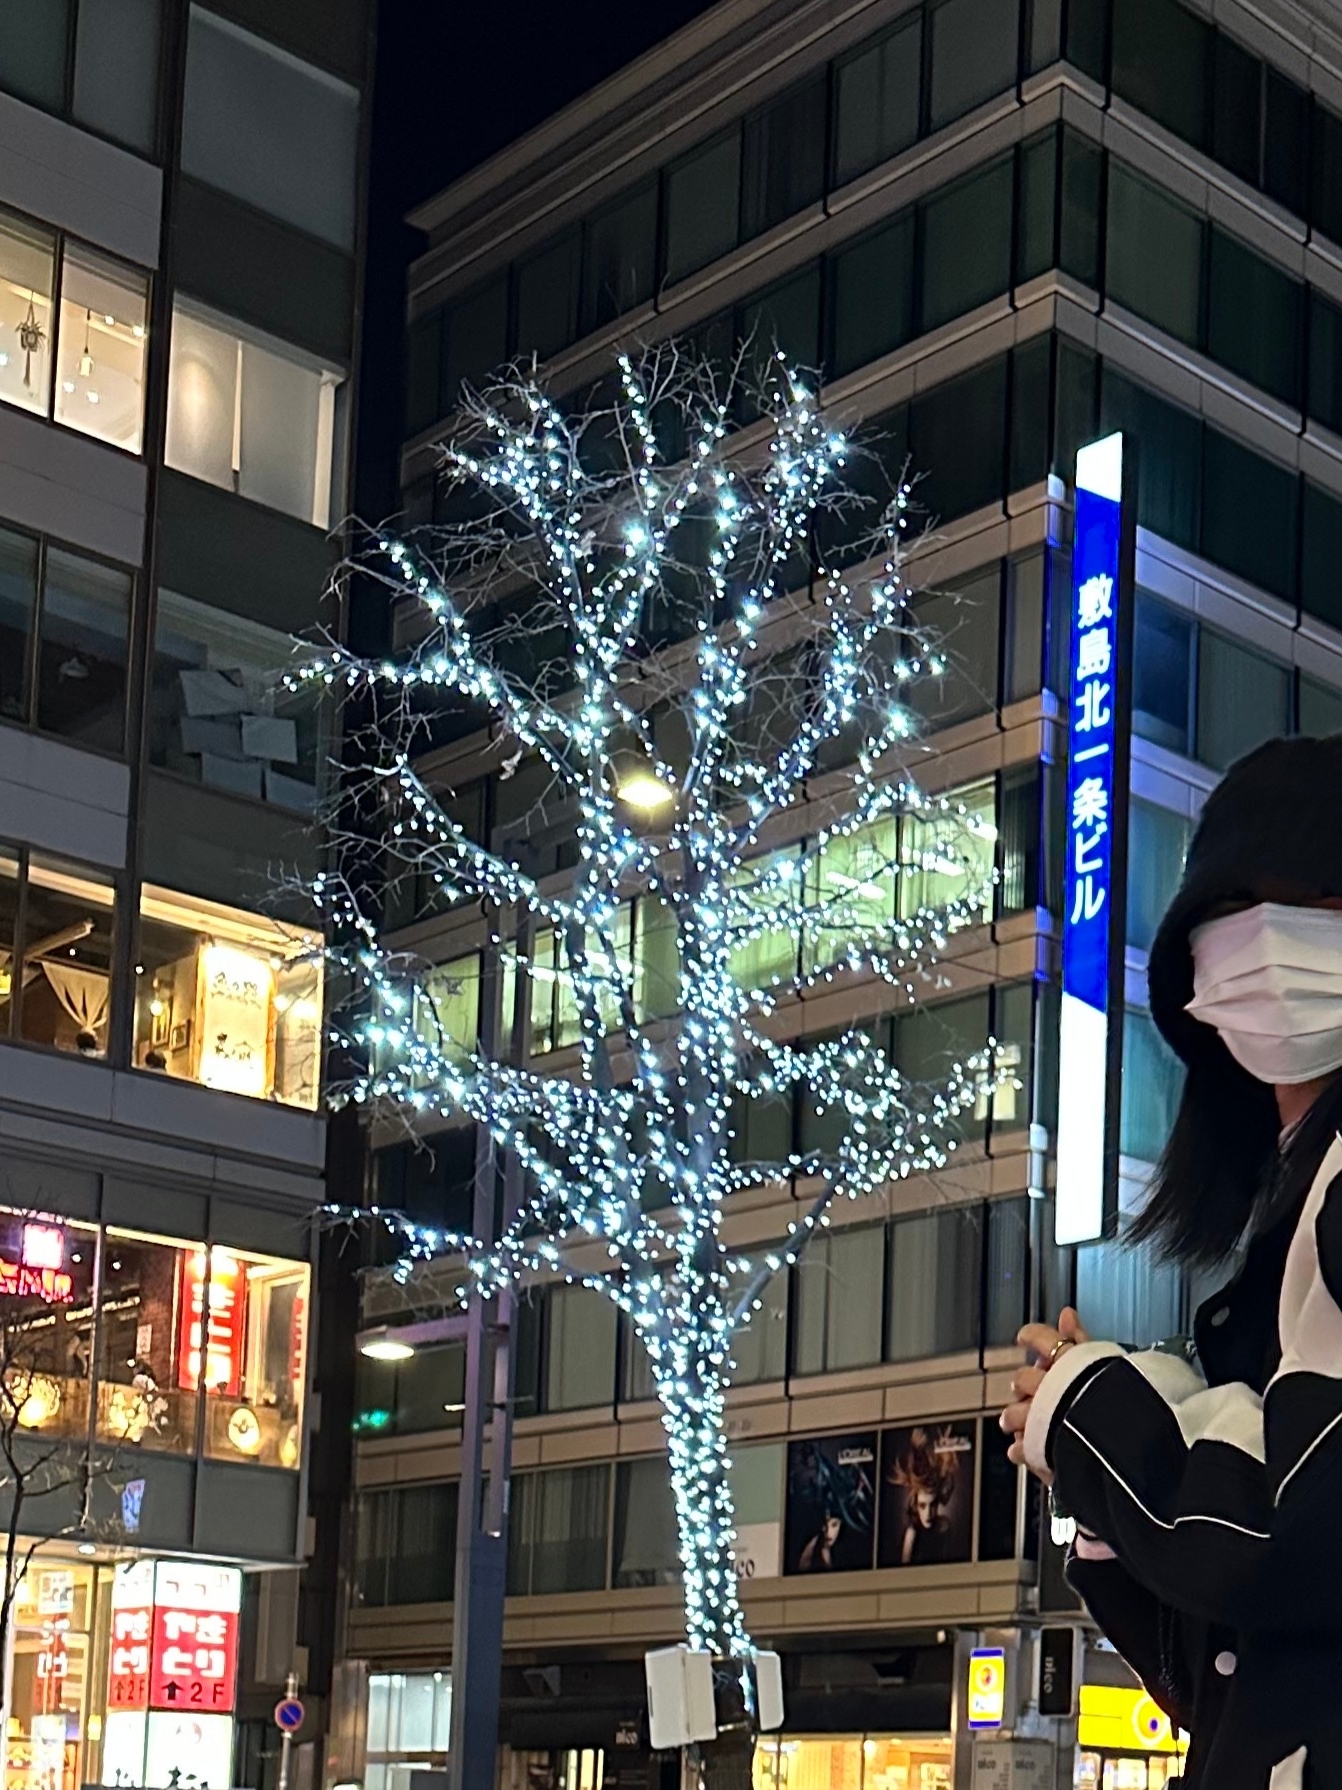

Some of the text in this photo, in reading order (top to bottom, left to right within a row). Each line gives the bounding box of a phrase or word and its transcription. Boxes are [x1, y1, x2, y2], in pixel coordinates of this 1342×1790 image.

[1070, 573, 1113, 924] 敷島北一条ビル
[163, 1611, 228, 1645] やき
[161, 1646, 226, 1679] とり
